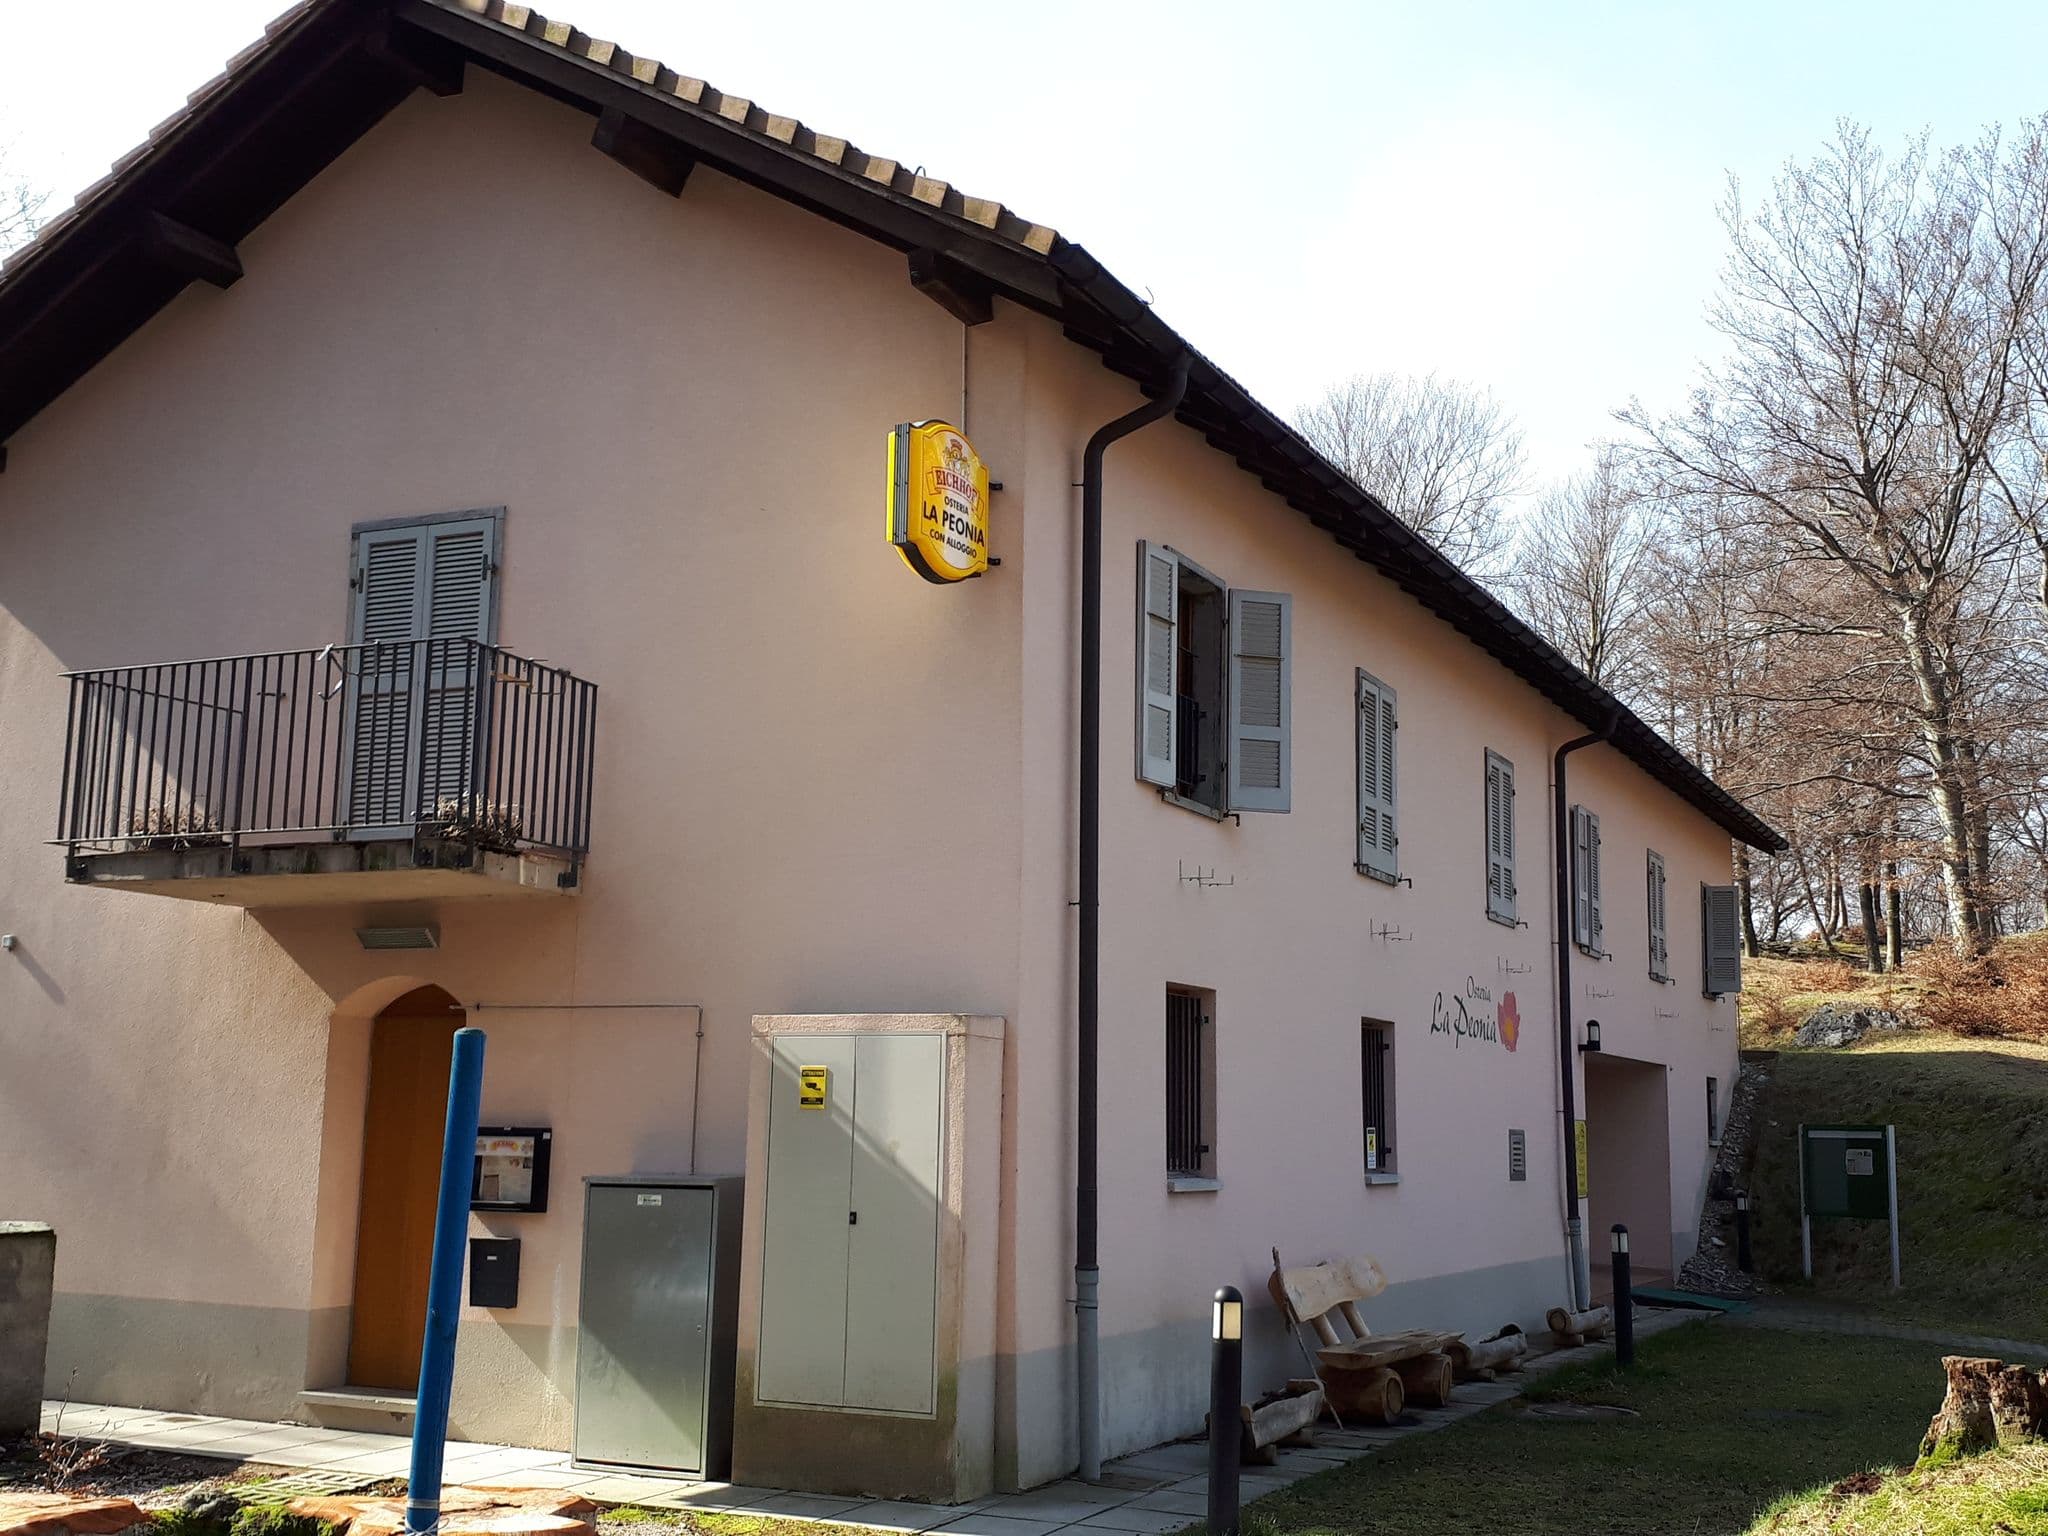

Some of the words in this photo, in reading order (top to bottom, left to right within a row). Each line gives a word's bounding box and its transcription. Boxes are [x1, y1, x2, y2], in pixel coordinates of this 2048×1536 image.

[935, 469, 977, 500] EICHHOF
[944, 496, 969, 516] OSTERIA
[923, 500, 938, 524] LA
[942, 509, 985, 547] PEONIA
[929, 528, 945, 544] CON
[946, 536, 977, 558] ALLOGGIO
[1466, 975, 1491, 1002] Osteria
[1431, 991, 1450, 1035] La
[1453, 994, 1497, 1049] Peonia
